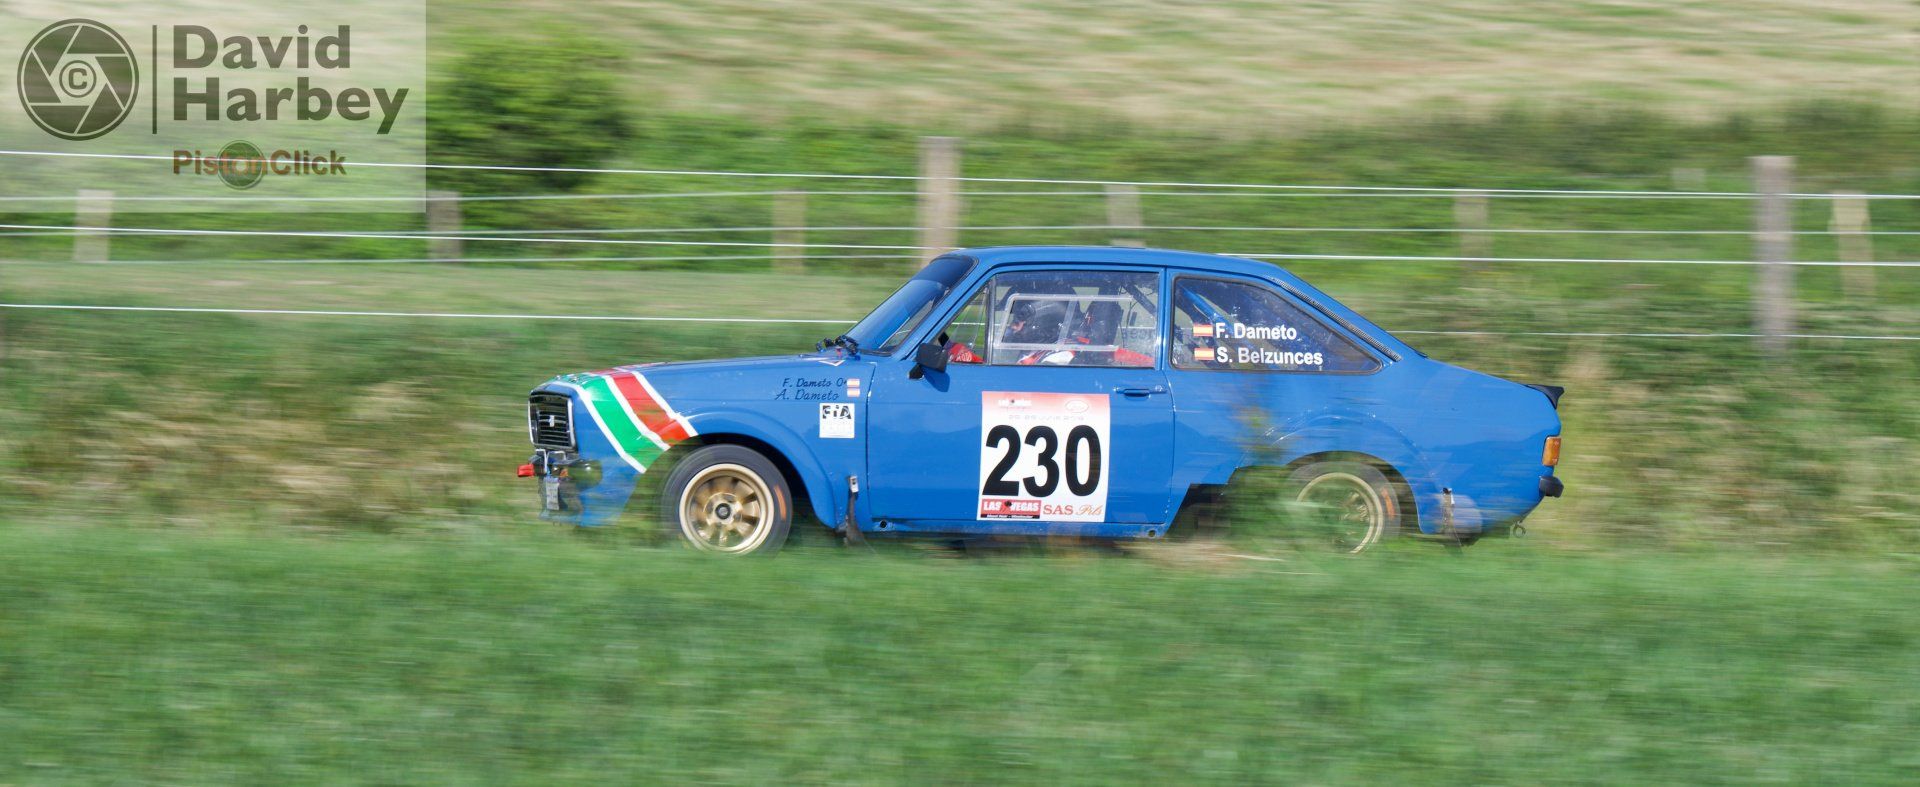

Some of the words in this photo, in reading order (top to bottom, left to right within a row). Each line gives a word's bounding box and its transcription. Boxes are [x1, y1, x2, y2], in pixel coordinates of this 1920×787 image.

[1215, 322, 1229, 339] F.
[1233, 322, 1298, 340] Dameto
[1216, 346, 1233, 363] S.
[1238, 347, 1324, 366] Belzunces
[782, 377, 793, 388] F.
[796, 377, 833, 388] Dameto
[774, 388, 790, 400] A.
[794, 388, 841, 401] Dameto
[981, 424, 1102, 498] 230
[983, 501, 1002, 511] LAS
[1010, 501, 1040, 512] VEGAS
[1042, 504, 1074, 515] SAS
